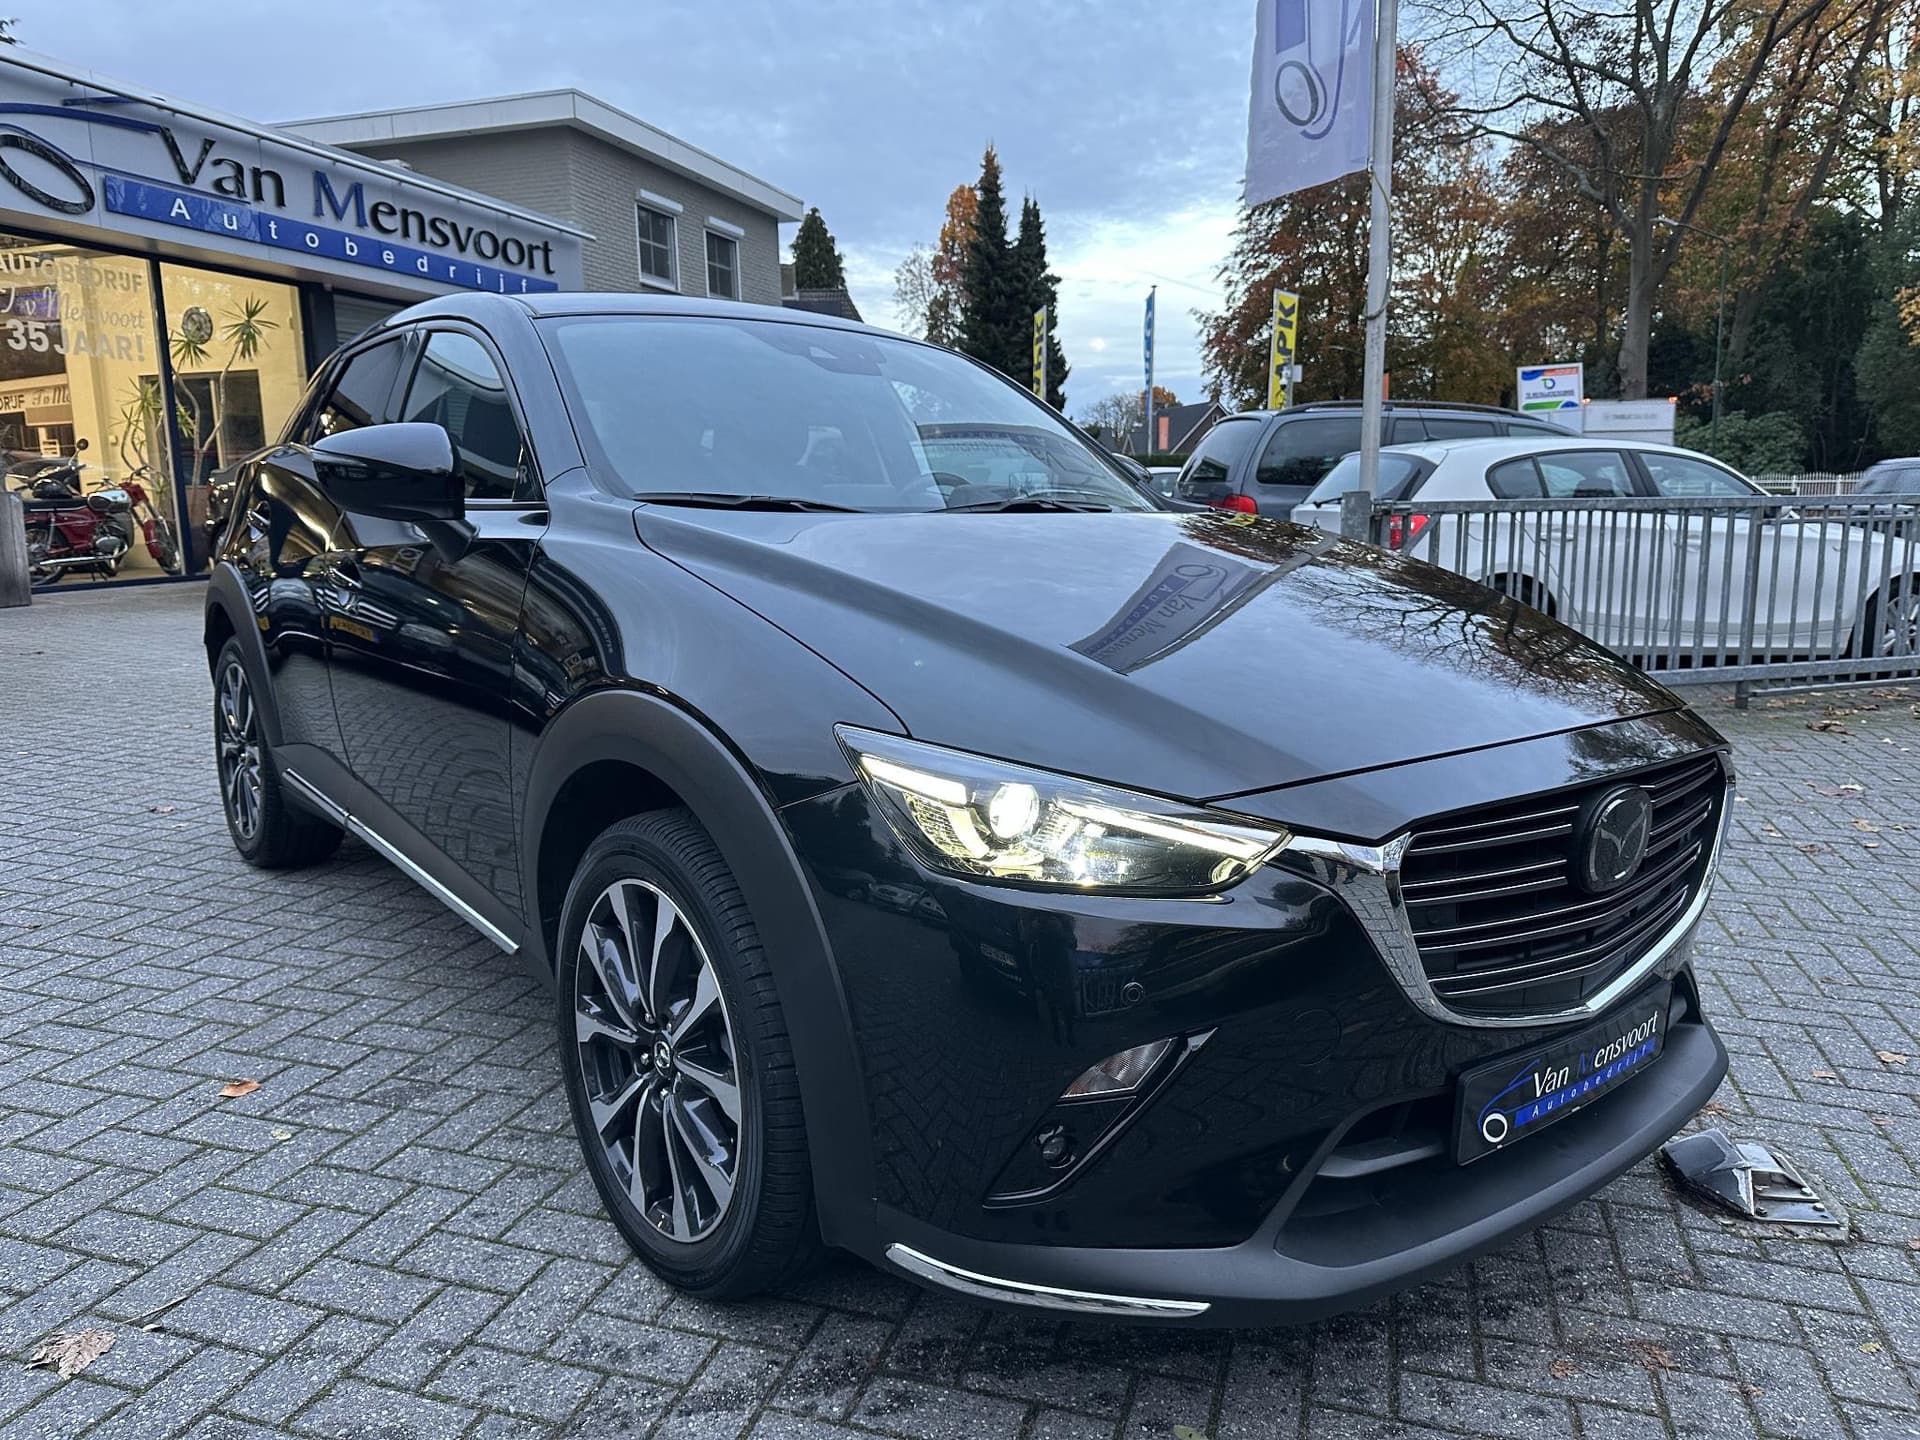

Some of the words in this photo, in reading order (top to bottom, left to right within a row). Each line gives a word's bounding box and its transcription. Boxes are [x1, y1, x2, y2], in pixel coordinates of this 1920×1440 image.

[159, 126, 287, 207] Van
[312, 170, 556, 275] Mensvoort
[170, 198, 528, 293] Autobedrijf
[6, 319, 49, 352] 35
[1532, 1044, 1647, 1118] Autobedrijf
[1534, 1066, 1569, 1098] Van
[1577, 1010, 1659, 1079] Mensvoort
